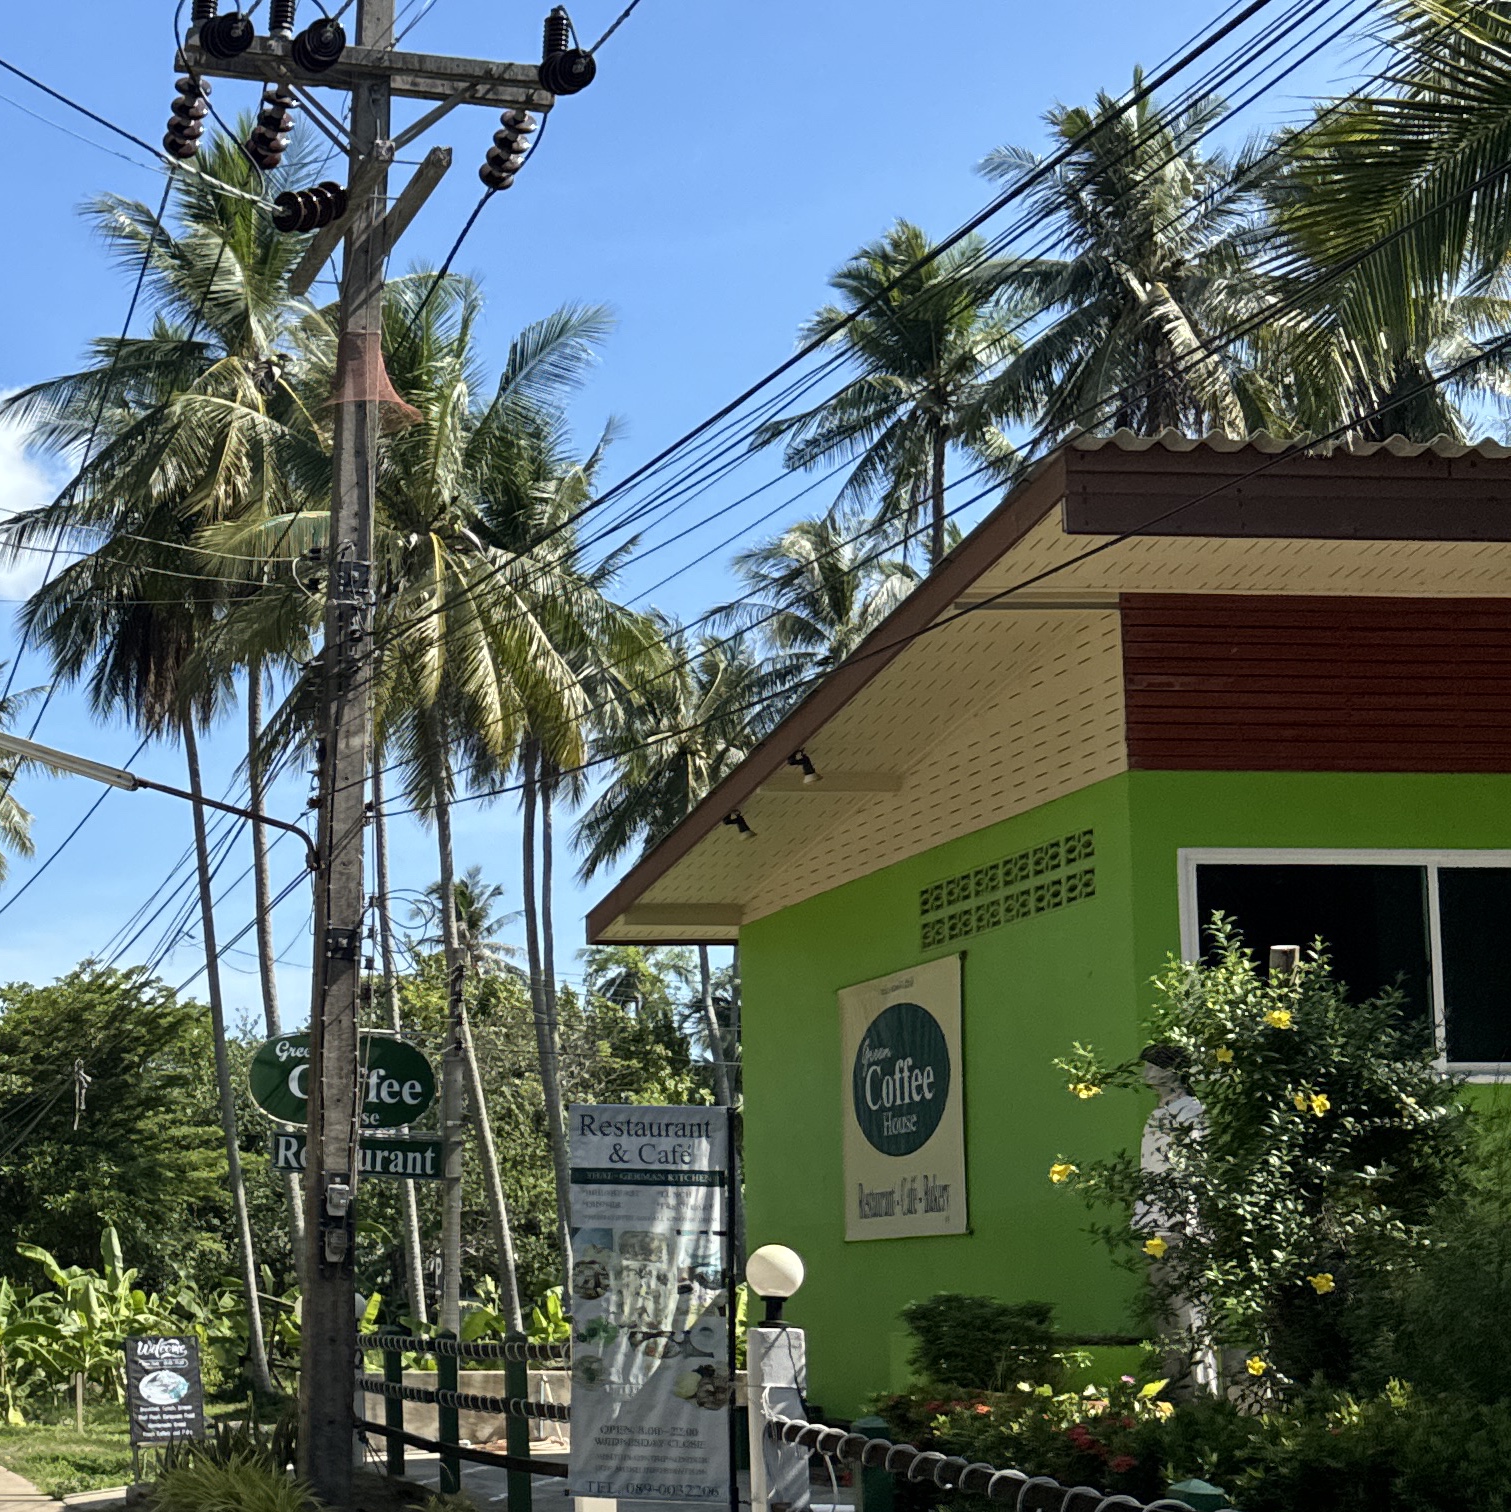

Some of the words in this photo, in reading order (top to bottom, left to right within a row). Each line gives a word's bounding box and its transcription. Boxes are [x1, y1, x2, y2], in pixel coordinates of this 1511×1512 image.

[275, 1041, 311, 1062] Gree
[288, 1064, 422, 1105] Cfee
[865, 1056, 936, 1112] Coffee
[579, 1114, 712, 1139] Restaurant
[882, 1111, 918, 1136] House
[608, 1143, 631, 1164] &
[638, 1143, 694, 1165] Café
